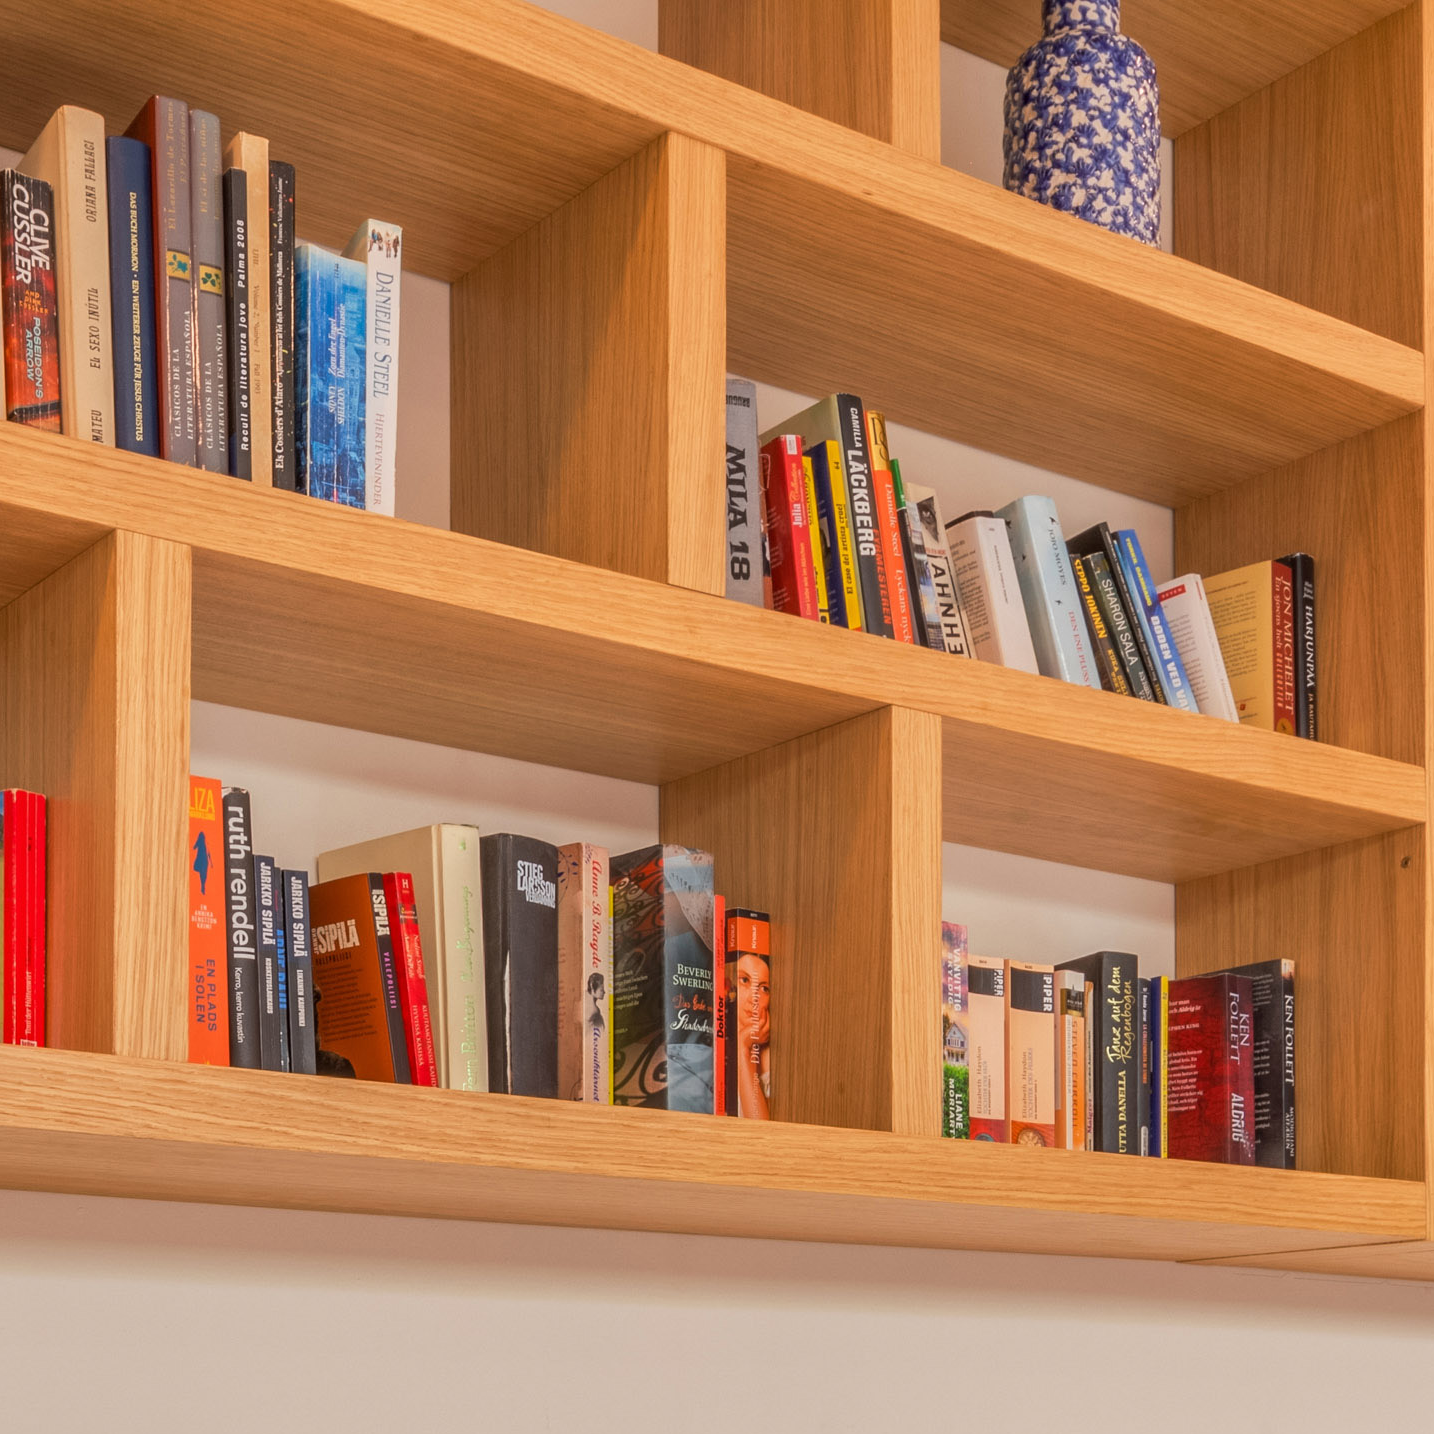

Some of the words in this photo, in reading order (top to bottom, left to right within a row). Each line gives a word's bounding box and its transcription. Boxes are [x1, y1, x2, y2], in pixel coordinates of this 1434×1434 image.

[85, 184, 97, 223] ORIANA
[129, 192, 137, 209] DAS
[129, 209, 138, 233] BUCH
[12, 183, 32, 285] CUSSLER
[29, 208, 50, 271] CLIVE
[130, 233, 139, 272] MORMON
[236, 219, 245, 247] 2008
[236, 249, 246, 289] Palma
[375, 271, 394, 347] DANIELLE
[25, 328, 35, 382] ARROW
[89, 326, 100, 354] SEXO
[239, 329, 249, 393] literatura
[373, 346, 392, 399] STEEL
[134, 402, 144, 441] CHRISTUS
[275, 402, 284, 449] Cossiers
[336, 387, 346, 425] SHELDON
[850, 407, 863, 448] CAMILLA
[726, 441, 748, 530] MILA
[847, 448, 877, 557] LÄCKBERG
[885, 483, 897, 528] Danielle
[729, 541, 751, 581] 18
[1084, 589, 1108, 639] JOKINEN
[1280, 575, 1292, 617] JON
[1101, 578, 1126, 632] SHARON
[1120, 631, 1139, 666] SALA
[1282, 619, 1296, 715] MICHELET
[227, 806, 251, 860] ruth
[260, 862, 273, 907] JARKKO
[517, 860, 543, 880] STIEG
[517, 875, 556, 899] LARSSON
[592, 861, 603, 898] Anne
[230, 868, 256, 961] rendell
[290, 876, 304, 920] JARKKO
[262, 908, 276, 945] SIPILÄ
[292, 921, 308, 958] SIPILÄ
[316, 919, 361, 955] SIPILÄ
[590, 920, 603, 969] Ragde
[206, 959, 216, 978] EN
[383, 951, 397, 1010] VALEPOLIISI
[677, 963, 712, 980] BEVERLY
[952, 947, 963, 1012] VANVITTIG
[196, 973, 205, 1023] SOLEN
[207, 983, 217, 1032] PLADS
[234, 991, 243, 1011] kerro
[1043, 976, 1053, 1013] PIPER
[1284, 994, 1294, 1023] KEN
[236, 1012, 245, 1044] kuvastin
[716, 994, 724, 1040] Doktor
[1119, 979, 1136, 1064] Regenbogen
[1229, 991, 1241, 1065] FOLLETT
[1239, 1012, 1250, 1047] KEN
[751, 1043, 760, 1065] Die
[1106, 1026, 1122, 1063] Tanz
[1285, 1025, 1296, 1087] FOLLETT
[954, 1092, 964, 1130] LIANE
[1118, 1070, 1127, 1121] DANELLA
[1118, 1123, 1127, 1154] UTTA
[1230, 1092, 1245, 1143] ALDRIG
